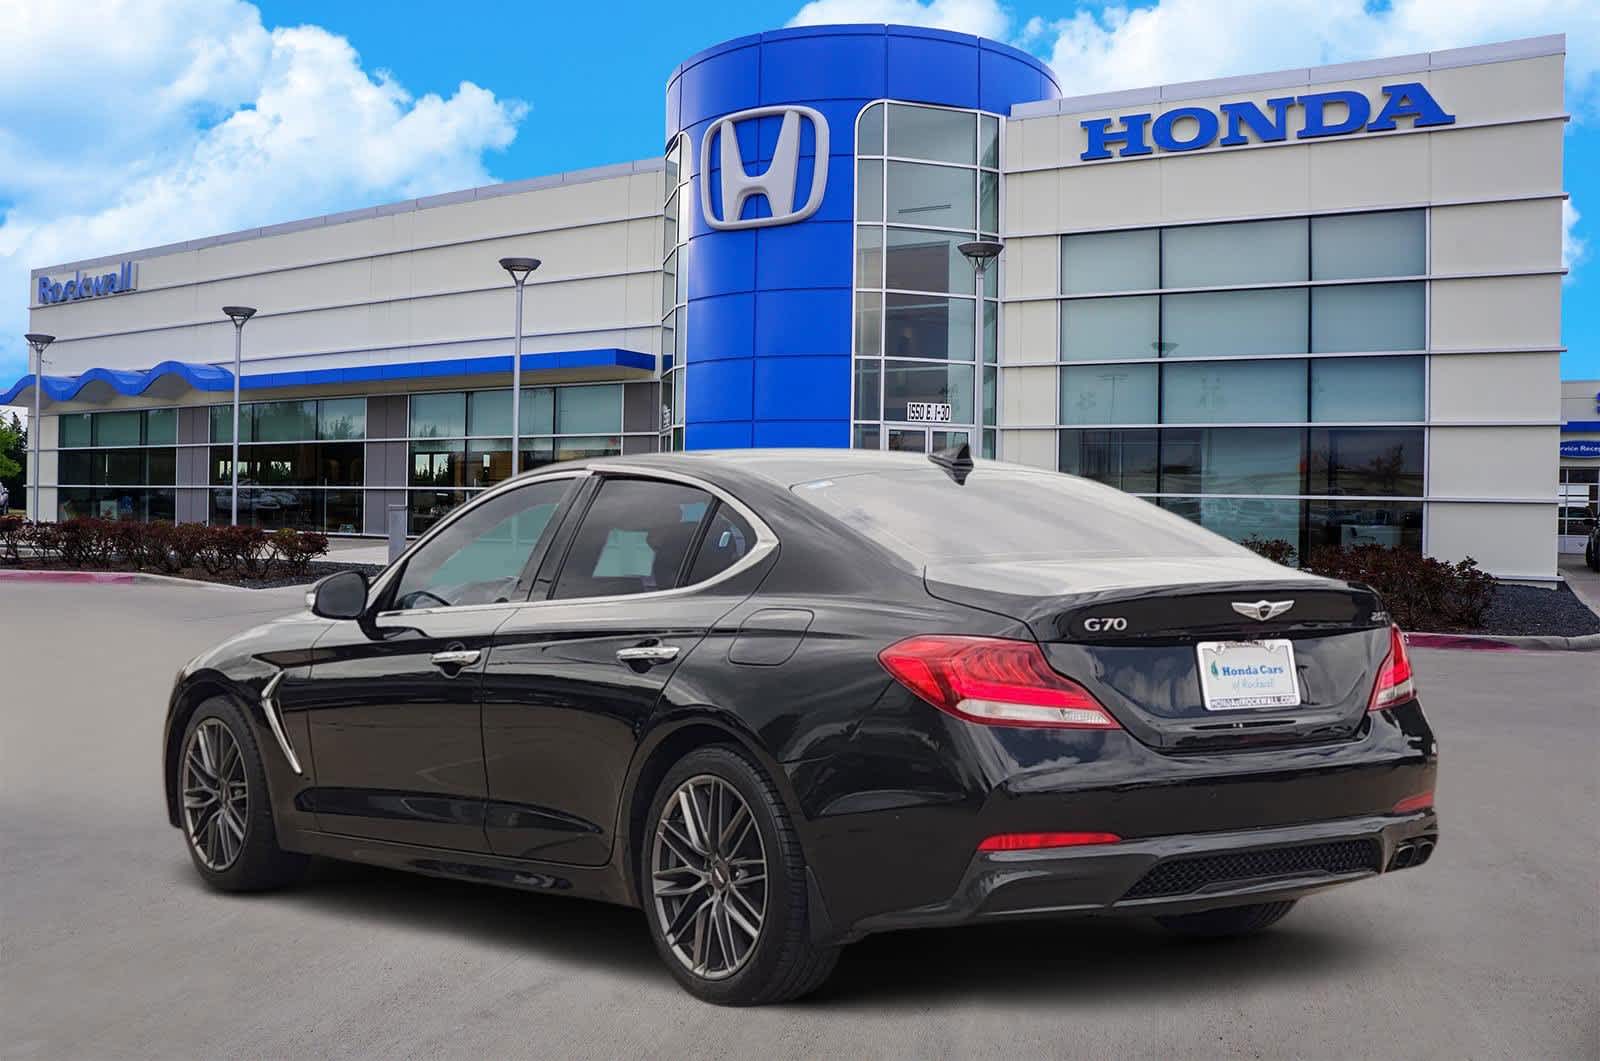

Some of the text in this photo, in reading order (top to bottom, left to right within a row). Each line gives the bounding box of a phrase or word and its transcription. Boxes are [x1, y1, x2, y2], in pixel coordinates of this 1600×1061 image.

[1079, 82, 1456, 161] HONDA
[38, 260, 134, 304] Rockwall
[908, 403, 925, 420] 1550
[1084, 617, 1128, 631] G70
[1222, 664, 1284, 676] Honda Cars
